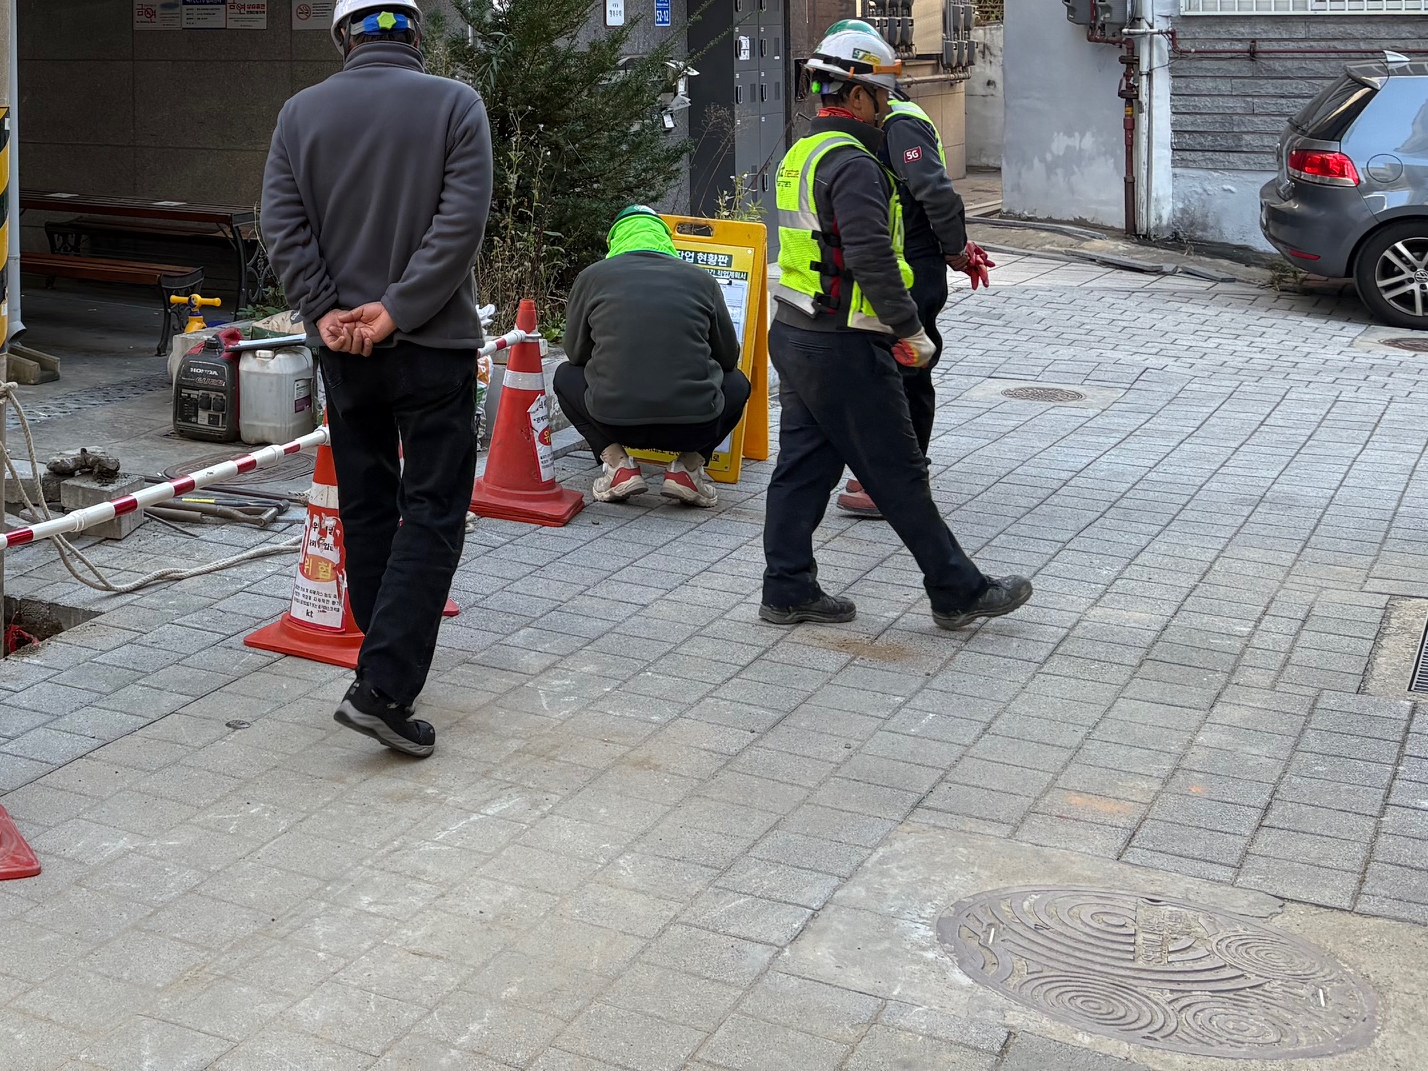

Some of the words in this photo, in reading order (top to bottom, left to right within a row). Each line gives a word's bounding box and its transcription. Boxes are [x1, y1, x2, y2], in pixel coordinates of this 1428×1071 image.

[906, 150, 919, 160] 5G
[696, 252, 729, 267] 현황판
[189, 367, 219, 376] HONDA
